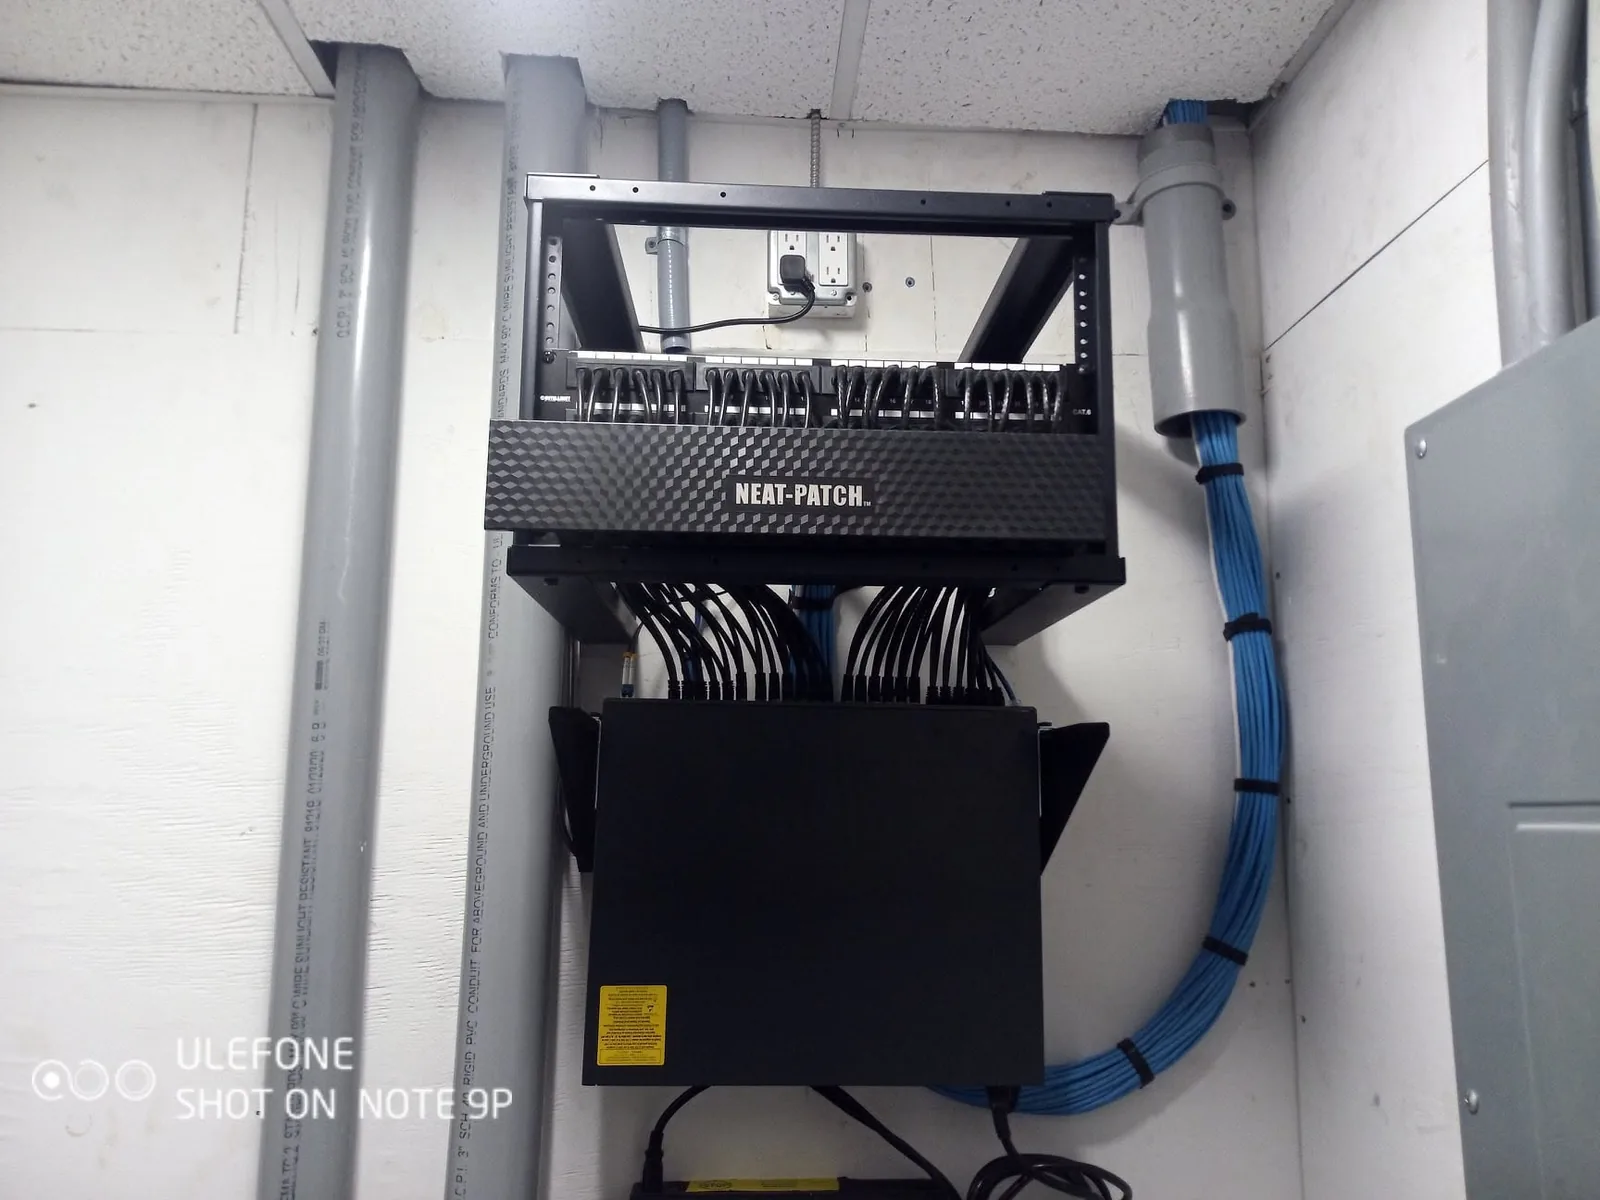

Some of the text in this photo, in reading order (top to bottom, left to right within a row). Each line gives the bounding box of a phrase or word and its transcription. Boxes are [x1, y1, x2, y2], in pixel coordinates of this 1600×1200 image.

[735, 482, 863, 507] NEAT-PATCH
[491, 558, 502, 575] TO
[488, 575, 501, 639] CONFORMS
[484, 686, 496, 709] USE
[479, 711, 495, 800] UNDERGROUND
[477, 803, 490, 828] AND
[472, 831, 488, 923] ABOVEGROUND
[470, 927, 483, 953] FOR
[467, 959, 481, 1014] CONDUIT
[465, 1020, 478, 1045] PVC
[462, 1052, 476, 1086] RIGID
